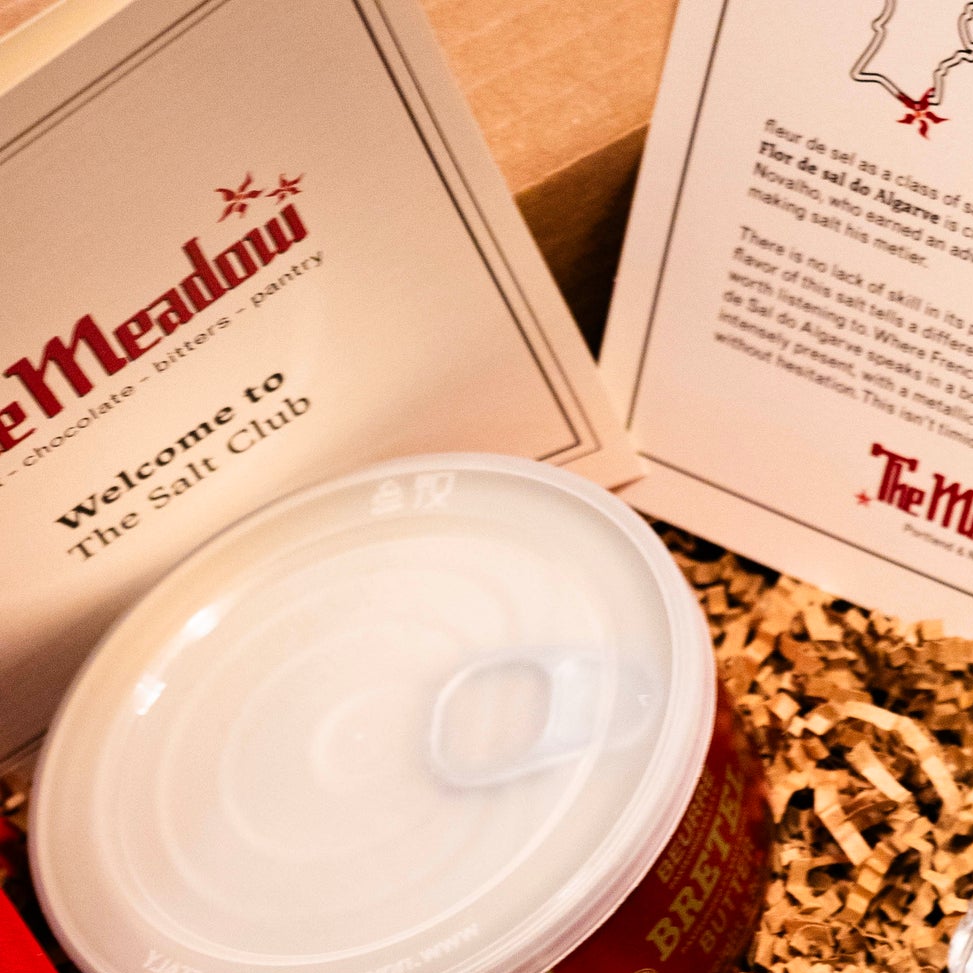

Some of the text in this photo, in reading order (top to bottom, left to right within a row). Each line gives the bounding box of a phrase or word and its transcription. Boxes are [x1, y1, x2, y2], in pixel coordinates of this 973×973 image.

[757, 139, 794, 165] Flor
[795, 155, 819, 175] de
[820, 169, 847, 187] sal
[847, 177, 872, 196] do
[872, 187, 941, 224] Algarve
[943, 215, 958, 232] is
[2, 202, 309, 420] Meadow
[21, 383, 136, 467] chocolate
[153, 315, 231, 373] bitters
[251, 250, 324, 307] pantry
[56, 403, 235, 530] Welcome
[243, 372, 285, 404] to
[67, 395, 312, 561] The Salt Club
[870, 443, 927, 518] The
